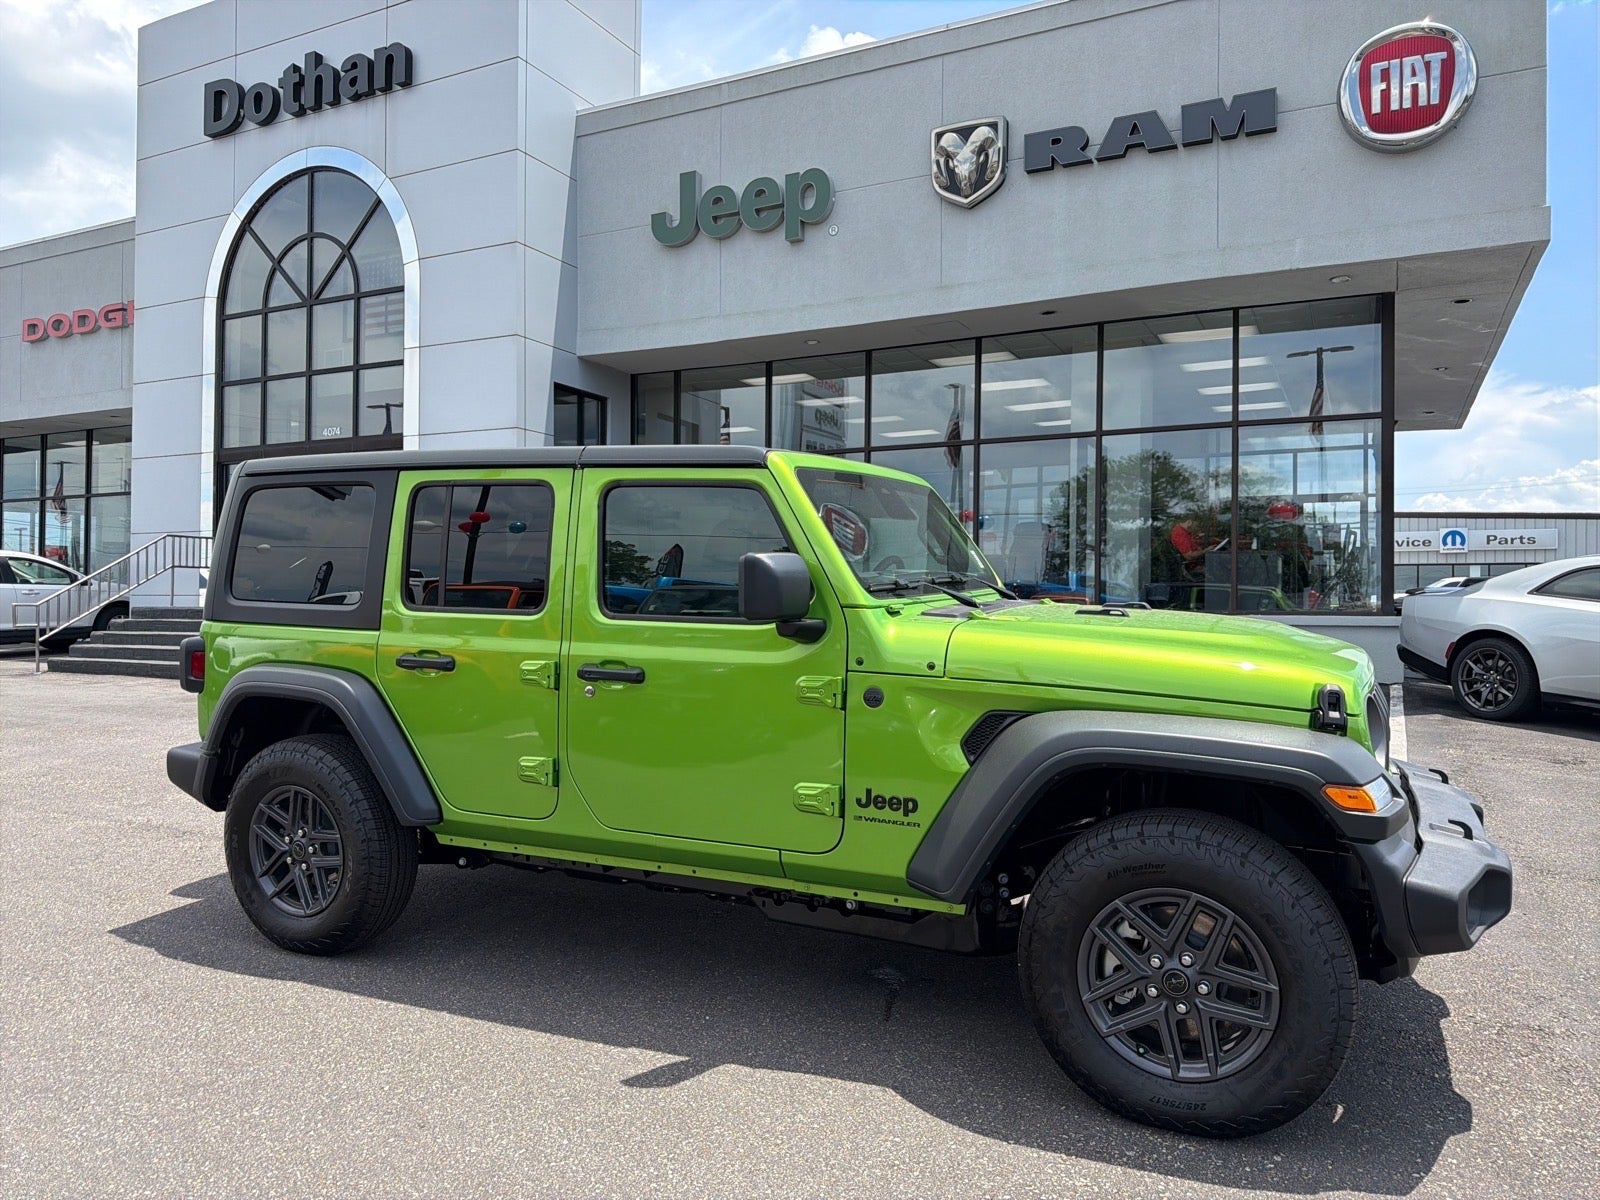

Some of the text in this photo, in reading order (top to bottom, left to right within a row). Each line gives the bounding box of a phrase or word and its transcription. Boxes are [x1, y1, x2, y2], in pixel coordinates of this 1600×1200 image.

[204, 42, 413, 138] Dothan
[1370, 51, 1448, 116] FIAT
[1024, 87, 1277, 174] RAM
[650, 167, 836, 247] Jeep
[322, 427, 341, 437] 4074
[1395, 537, 1433, 548] vice
[1486, 534, 1537, 545] Parts
[855, 787, 919, 817] Jeep
[863, 815, 921, 828] WRANGLER
[1107, 862, 1166, 880] All-Weather
[1149, 1095, 1207, 1111] 245/75R17
